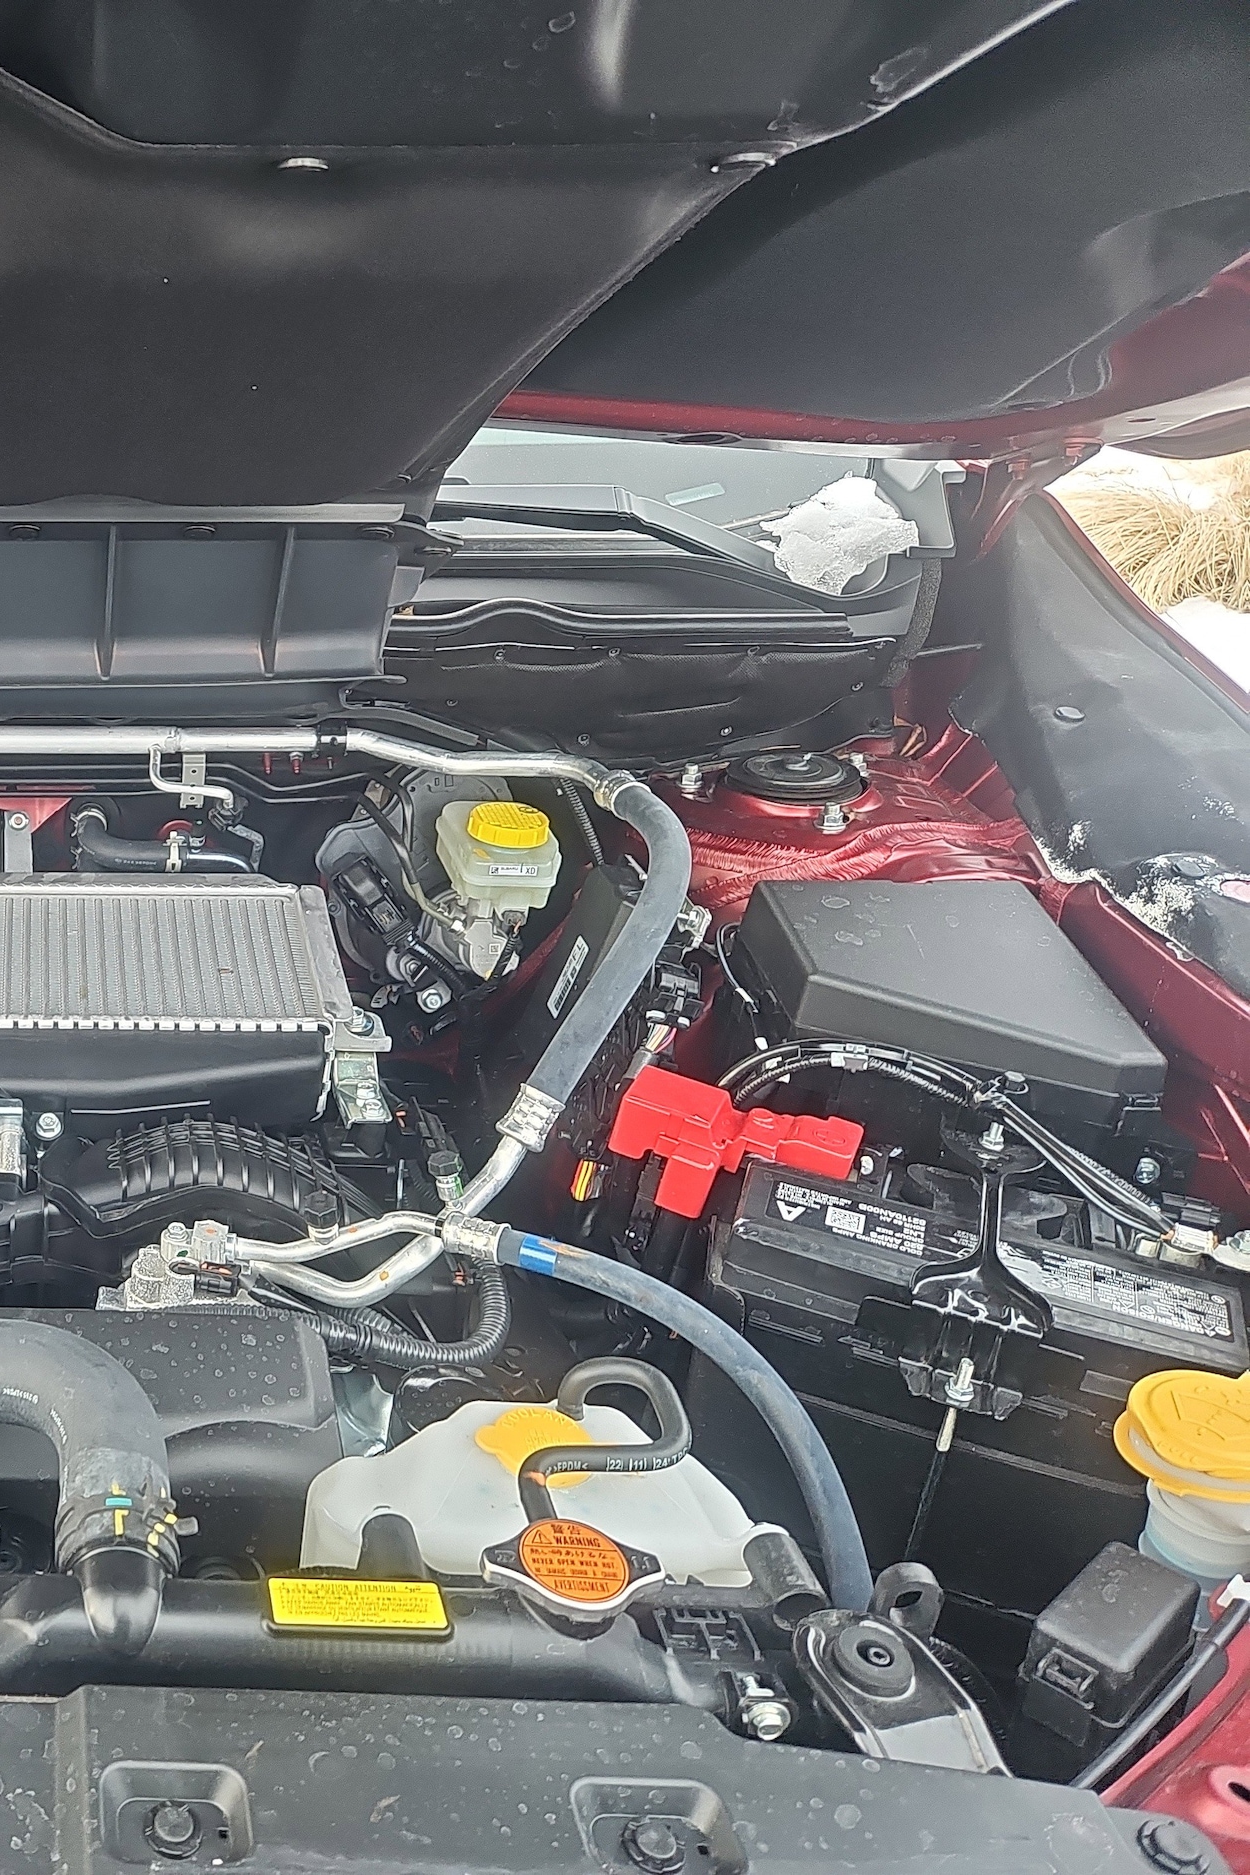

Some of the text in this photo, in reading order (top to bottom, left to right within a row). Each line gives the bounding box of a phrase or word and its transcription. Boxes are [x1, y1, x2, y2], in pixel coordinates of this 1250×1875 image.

[870, 1231, 902, 1245] AMPS
[894, 1232, 924, 1244] GROUP
[903, 1227, 925, 1238] LN2
[856, 1233, 898, 1249] CRANKING
[899, 1245, 923, 1256] COLD
[553, 1535, 601, 1548] WARNING
[557, 1558, 575, 1566] OPEN
[579, 1559, 599, 1567] WHEN
[314, 1583, 349, 1592] CAUTION
[354, 1584, 397, 1593] ATTENTION
